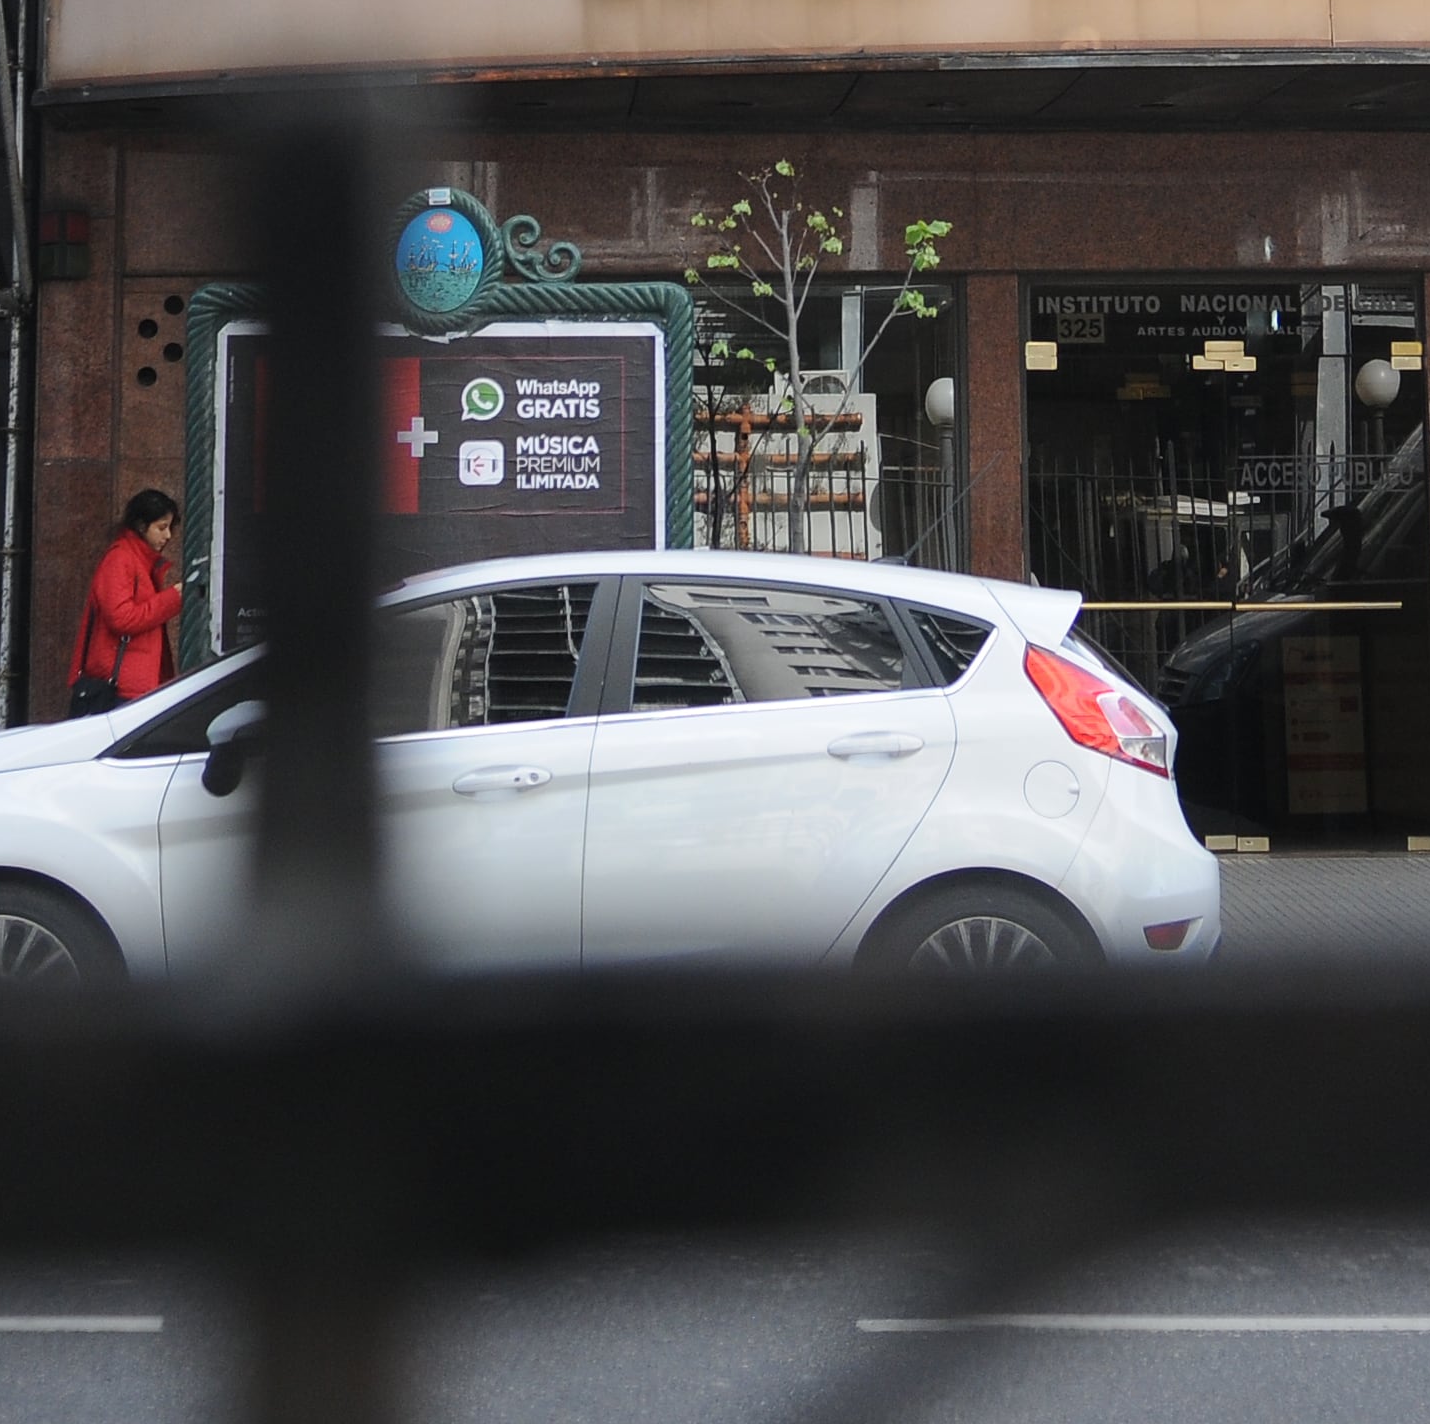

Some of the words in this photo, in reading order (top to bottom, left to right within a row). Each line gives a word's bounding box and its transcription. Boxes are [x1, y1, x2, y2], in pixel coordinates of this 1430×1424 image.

[1037, 294, 1162, 315] INSTITUTO
[1179, 294, 1298, 313] NACIONAL
[1059, 318, 1104, 339] 325
[1137, 326, 1186, 337] ARTES
[515, 379, 601, 398] WhatsApp
[516, 398, 601, 419] GRATIS
[516, 433, 600, 455] MÚSICA
[516, 456, 601, 473] PREMIUM
[516, 474, 600, 490] ILIMITADA
